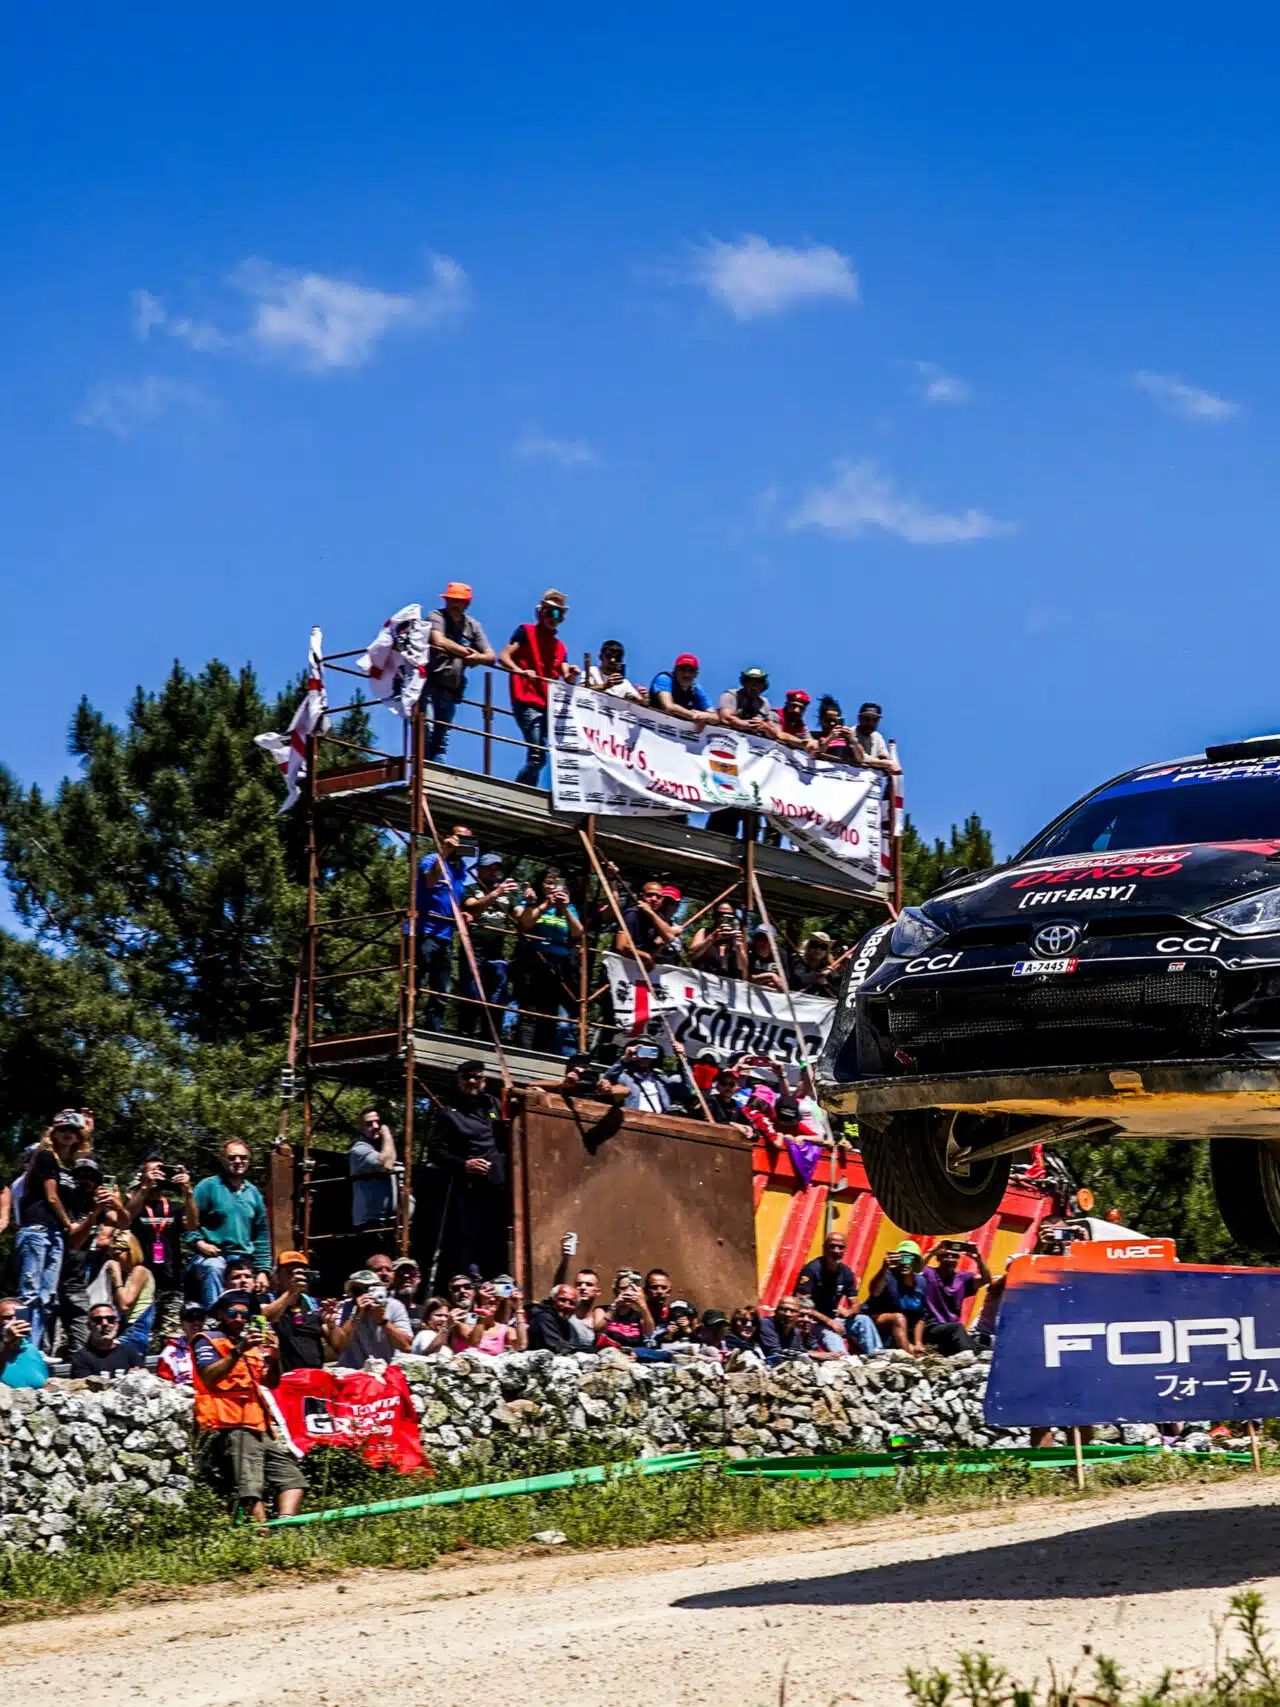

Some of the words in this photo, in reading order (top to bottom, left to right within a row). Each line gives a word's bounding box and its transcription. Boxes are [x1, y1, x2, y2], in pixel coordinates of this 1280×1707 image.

[1011, 863, 1183, 888] DENSO
[1019, 884, 1137, 909] [FIT-EASY]
[1025, 961, 1065, 973] A-7445
[1106, 1245, 1164, 1259] WRC
